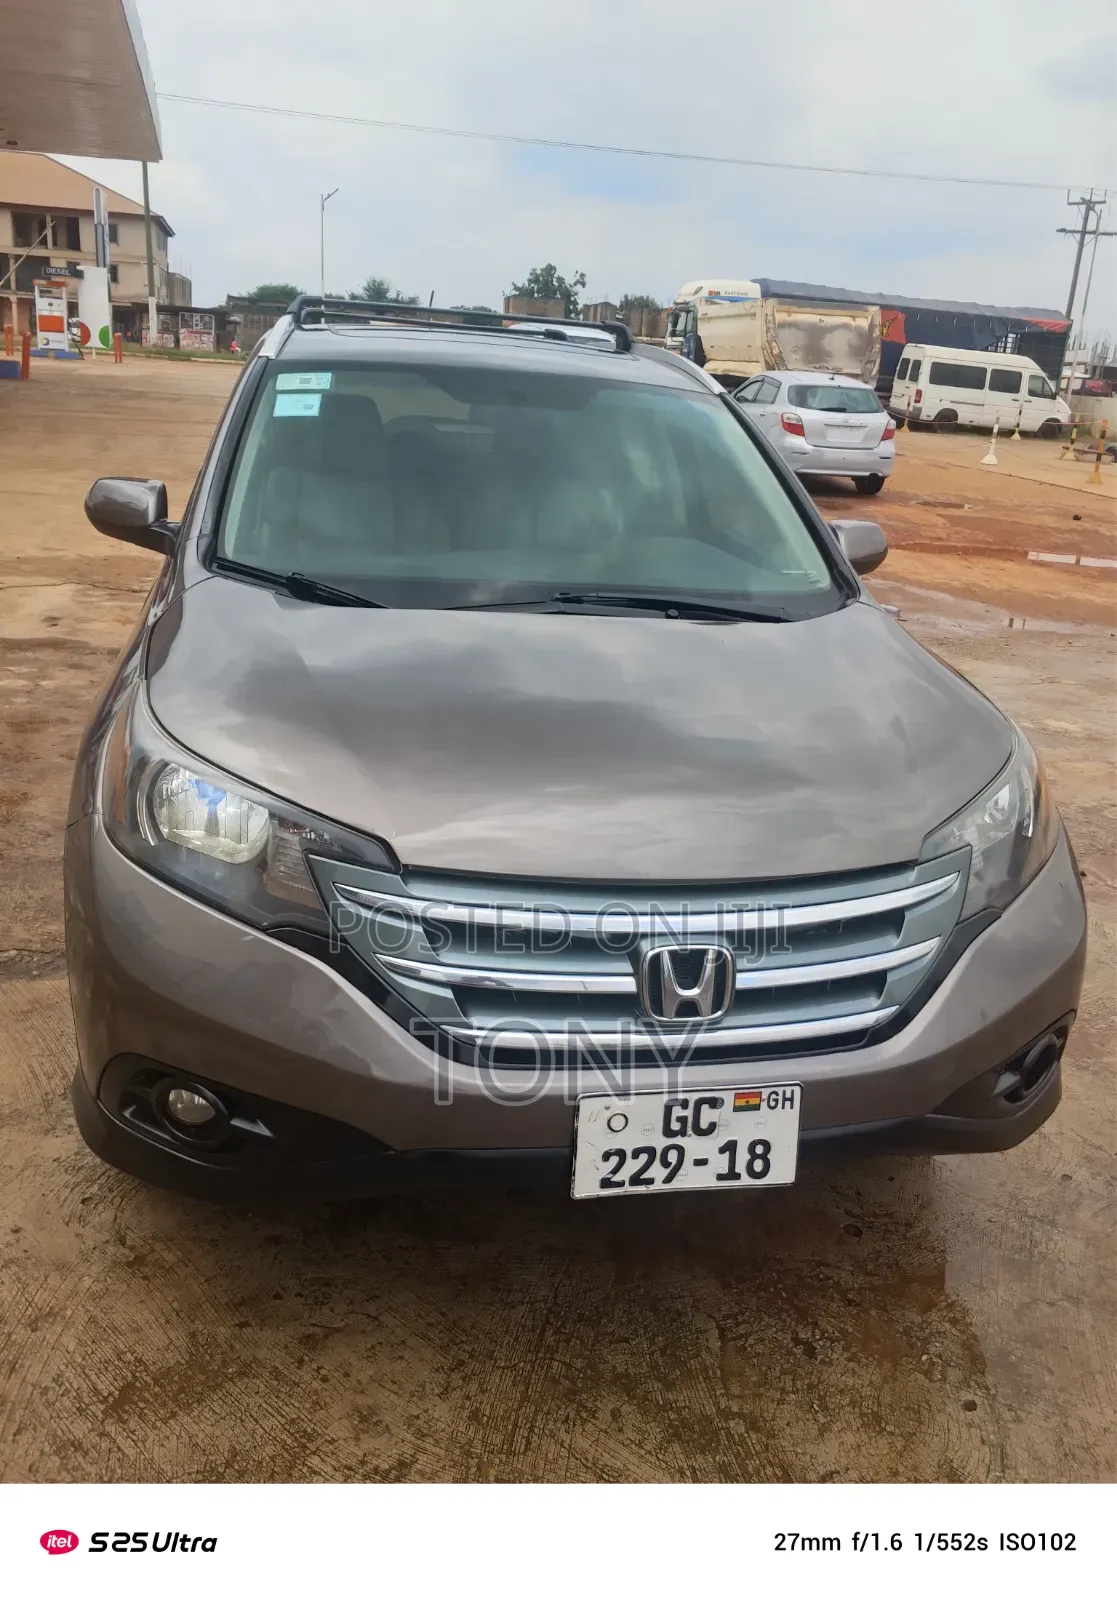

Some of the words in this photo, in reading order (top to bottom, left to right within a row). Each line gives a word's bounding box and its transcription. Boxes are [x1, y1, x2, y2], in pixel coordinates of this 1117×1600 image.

[45, 267, 71, 276] DIESEL
[662, 1096, 719, 1138] GC
[766, 1089, 795, 1111] GH
[599, 1138, 772, 1189] 229-18
